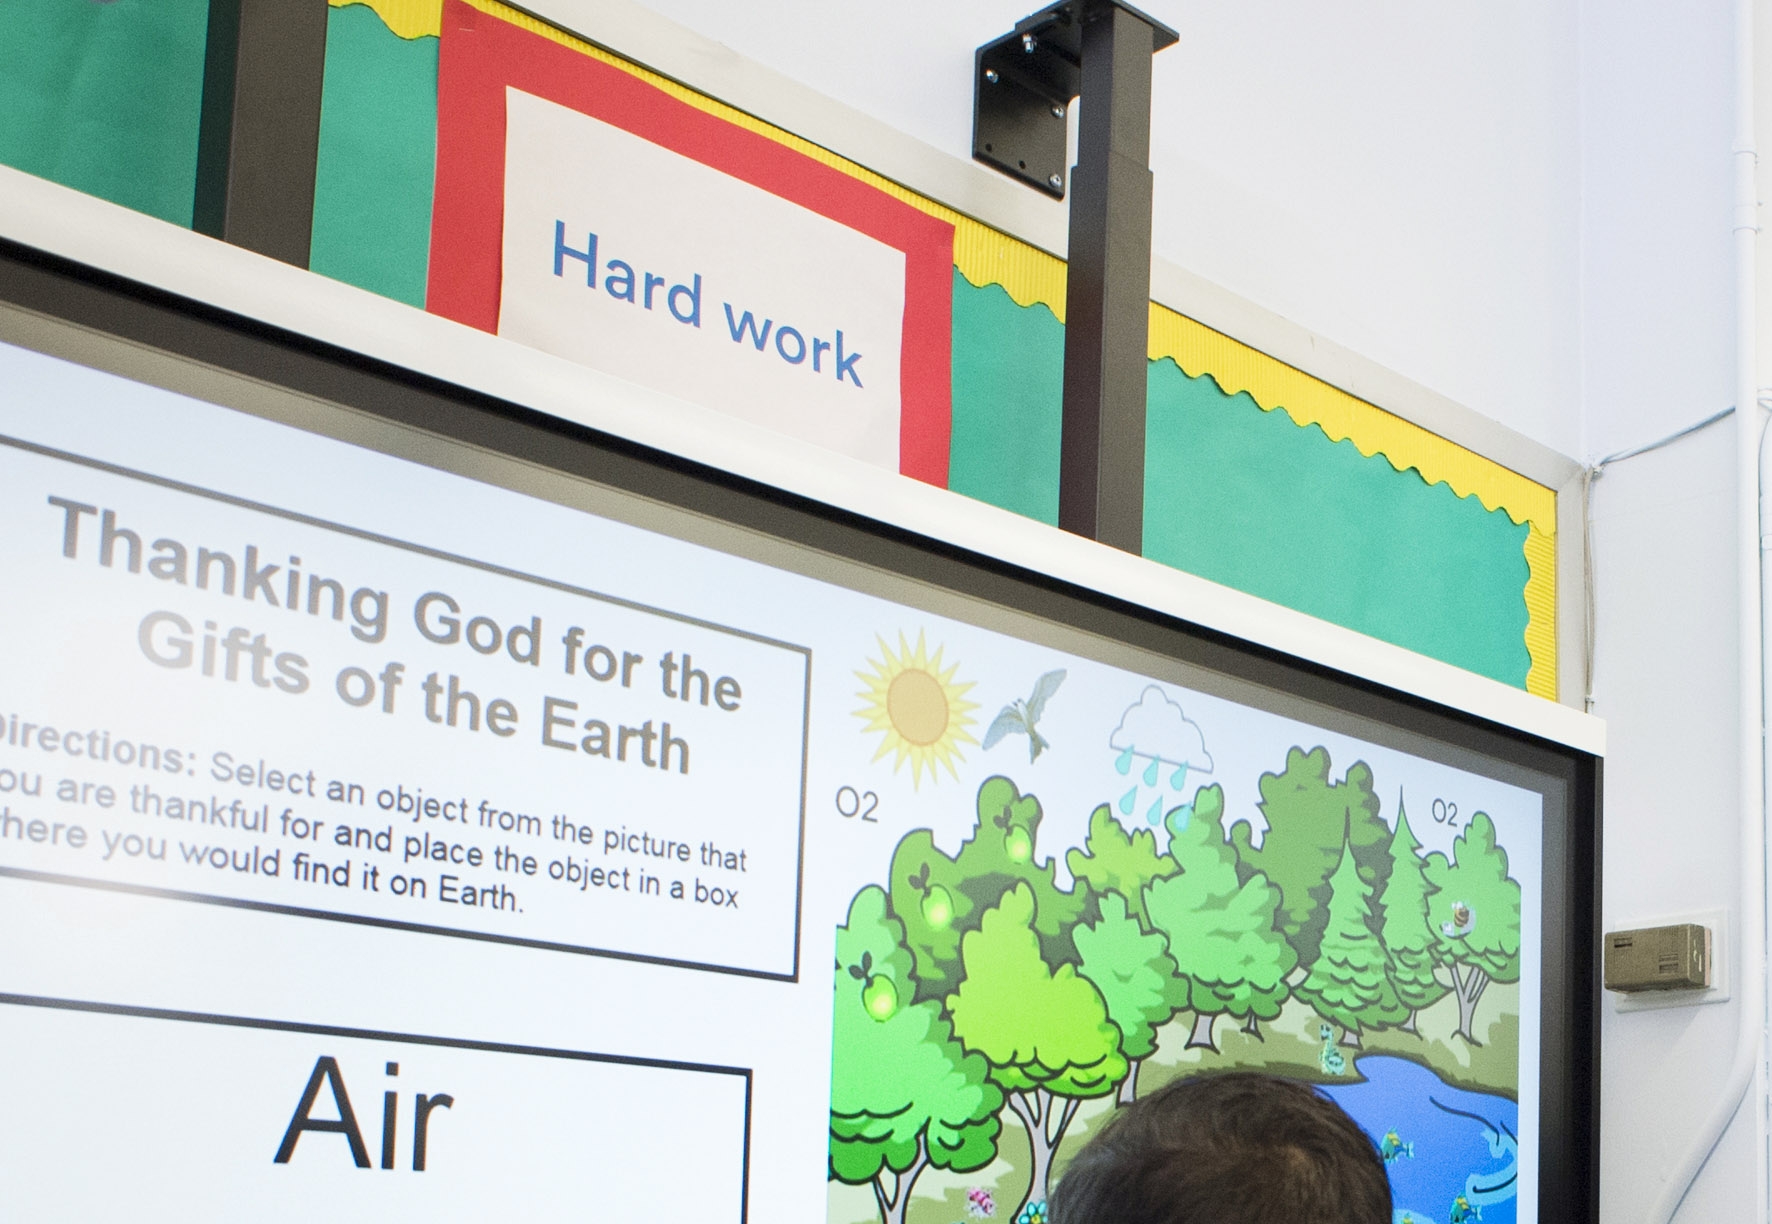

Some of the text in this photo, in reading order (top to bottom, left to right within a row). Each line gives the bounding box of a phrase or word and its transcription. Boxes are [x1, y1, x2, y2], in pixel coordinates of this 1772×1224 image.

[553, 219, 864, 388] Hard work
[48, 495, 742, 711] Thanking God for the
[137, 610, 690, 774] Gifts of the Earth
[0, 713, 747, 872] irections: Select an object from the picture that
[0, 768, 739, 908] ou are thankful for and place the object in a box
[0, 806, 524, 913] here you would find it on Earth.
[835, 786, 879, 823] O2
[1432, 798, 1458, 827] O2
[273, 1055, 454, 1171] Air
